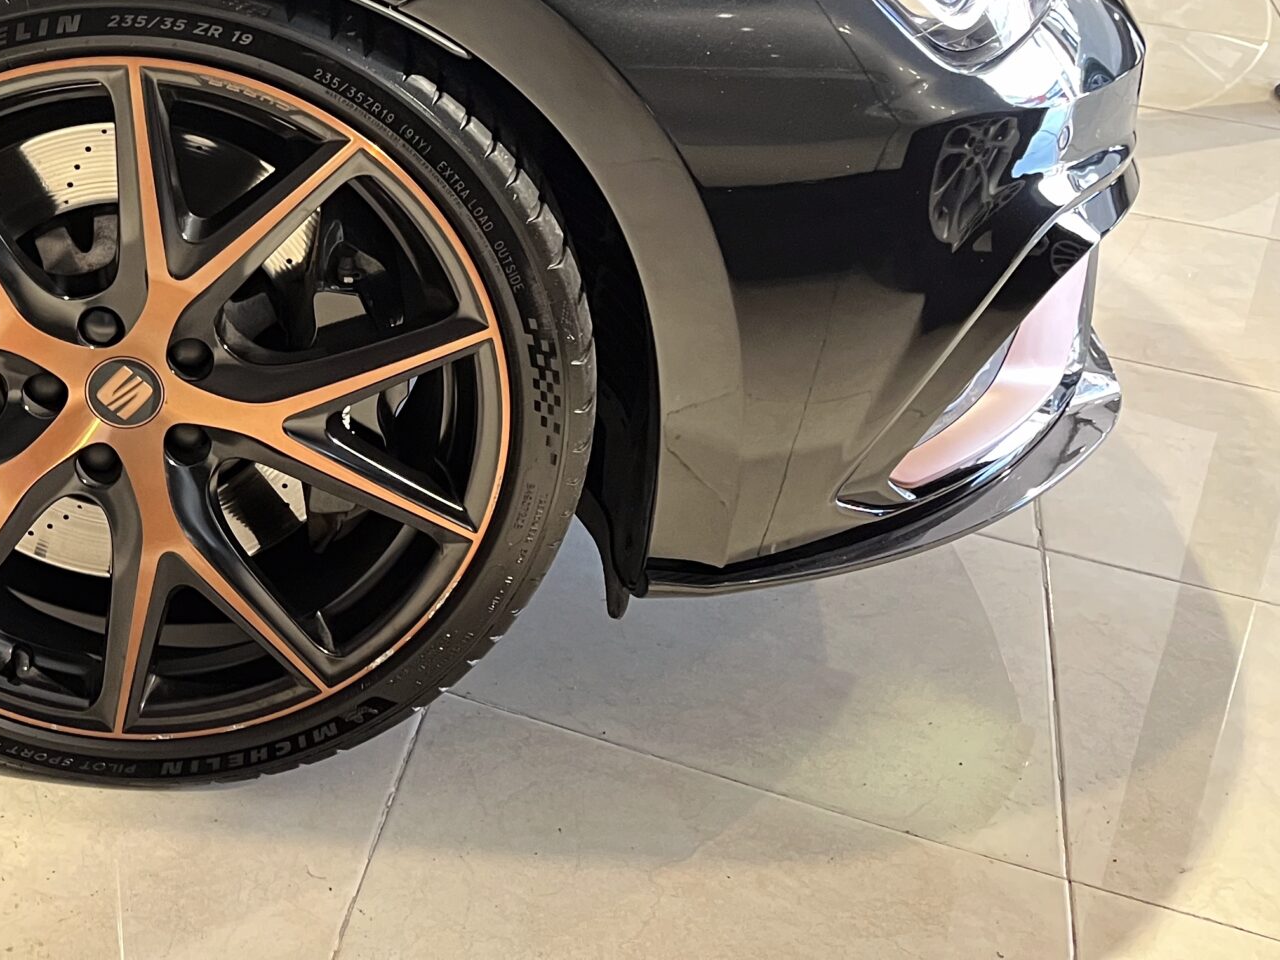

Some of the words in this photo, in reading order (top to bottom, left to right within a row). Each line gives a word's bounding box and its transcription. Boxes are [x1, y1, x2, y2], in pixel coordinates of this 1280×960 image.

[106, 14, 188, 32] 235/35
[192, 22, 224, 39] ZR
[231, 31, 254, 47] 19
[313, 68, 395, 124] 235/35ZR19
[400, 123, 431, 156] (91Y)
[436, 161, 470, 199] EXTRA
[467, 199, 494, 232] LOAD
[493, 240, 525, 292] OUTSIDE
[5, 746, 74, 767] SPORT
[161, 722, 338, 776] MICHELIN
[79, 761, 137, 774] PILOT
